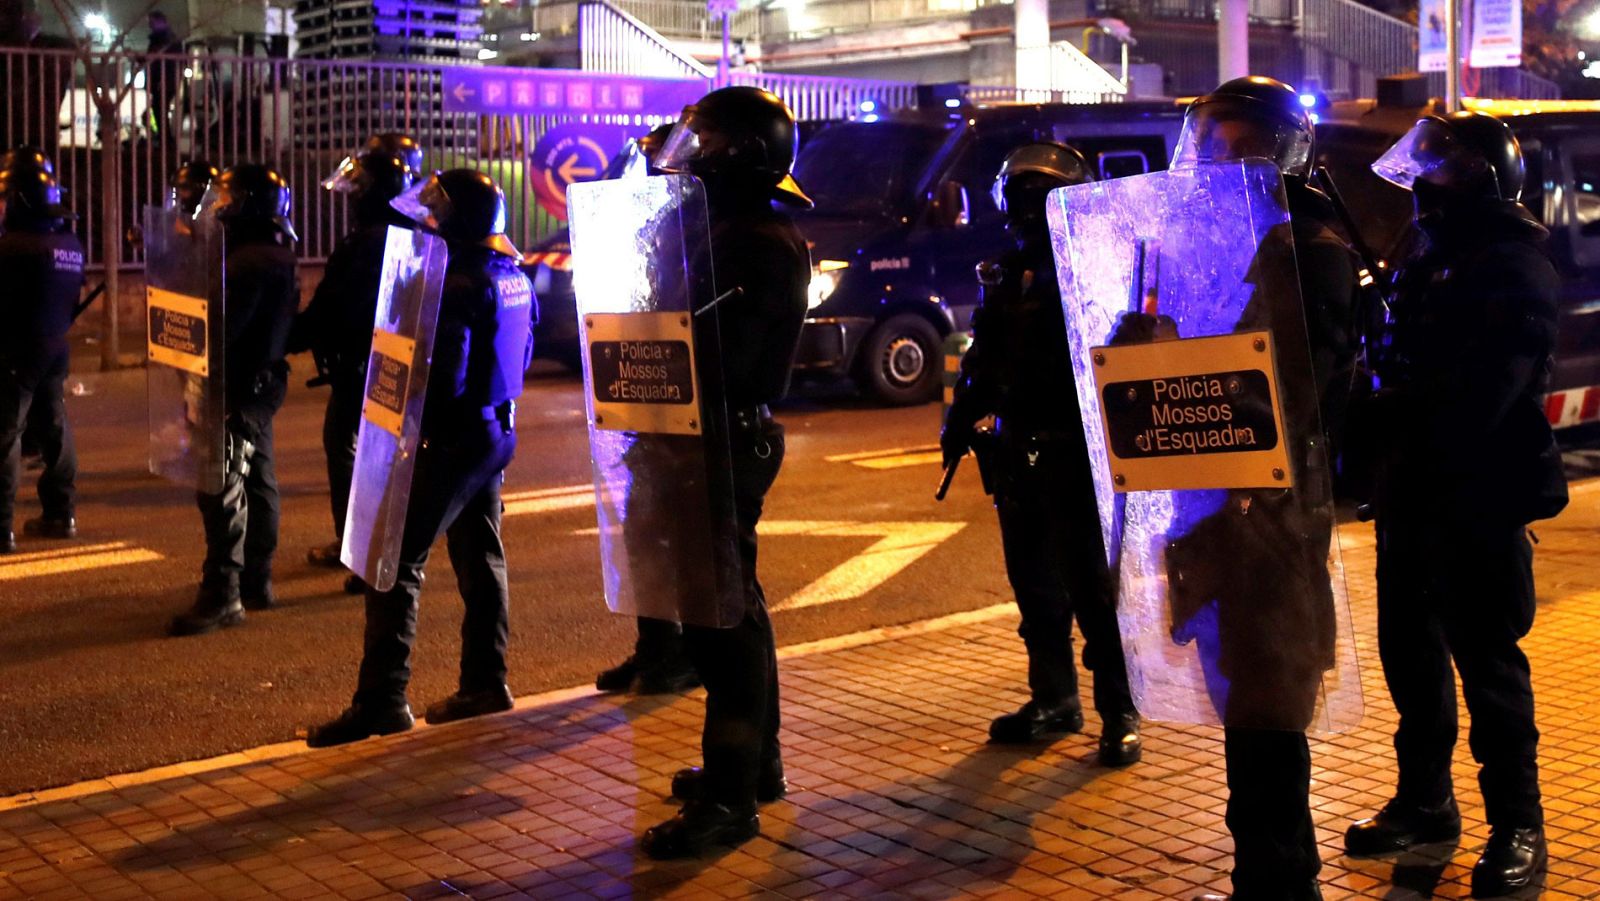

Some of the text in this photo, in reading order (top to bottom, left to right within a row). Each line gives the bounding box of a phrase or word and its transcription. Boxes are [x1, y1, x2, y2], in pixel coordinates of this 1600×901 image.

[53, 248, 83, 265] POLICIA
[870, 257, 901, 271] policia
[498, 274, 530, 296] POLICIA
[620, 342, 663, 359] Policia
[618, 361, 668, 379] Mossos
[609, 380, 681, 403] d'Esquadra
[1152, 376, 1224, 402] Policia
[1151, 403, 1233, 426] Mossos
[1140, 424, 1256, 454] d'Esquadra
